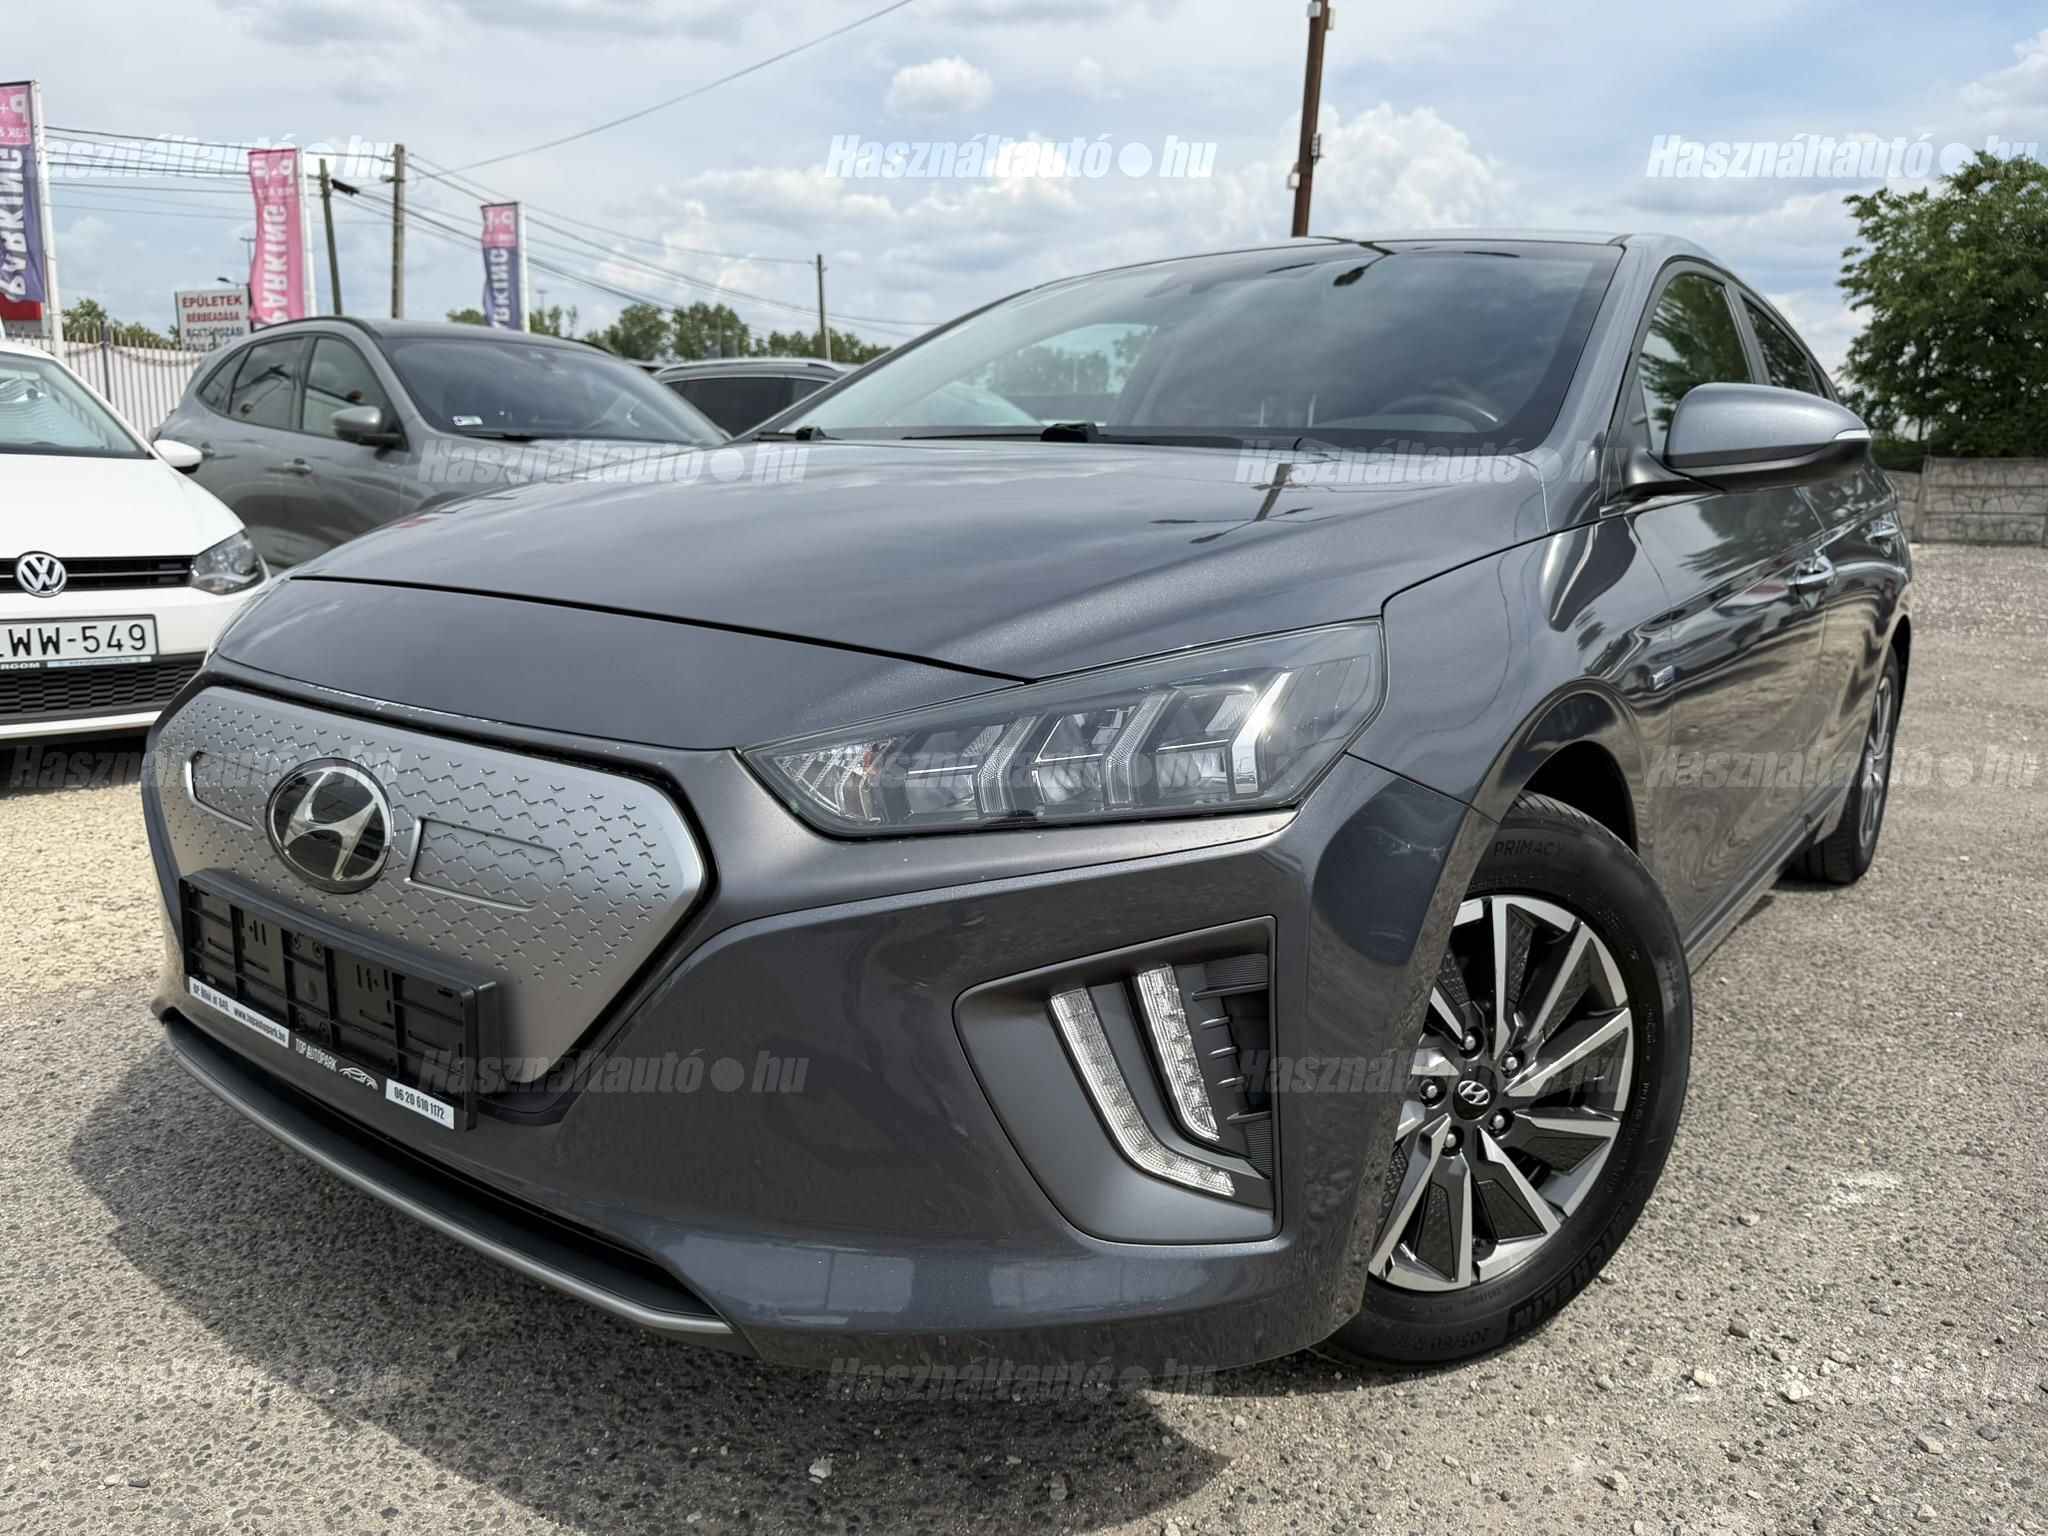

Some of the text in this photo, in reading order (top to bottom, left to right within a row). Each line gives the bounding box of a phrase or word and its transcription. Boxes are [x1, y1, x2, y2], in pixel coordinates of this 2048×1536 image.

[0, 623, 147, 657] WW-549
[295, 1038, 307, 1055] TOP
[394, 1086, 445, 1120] 06 20 610 1172
